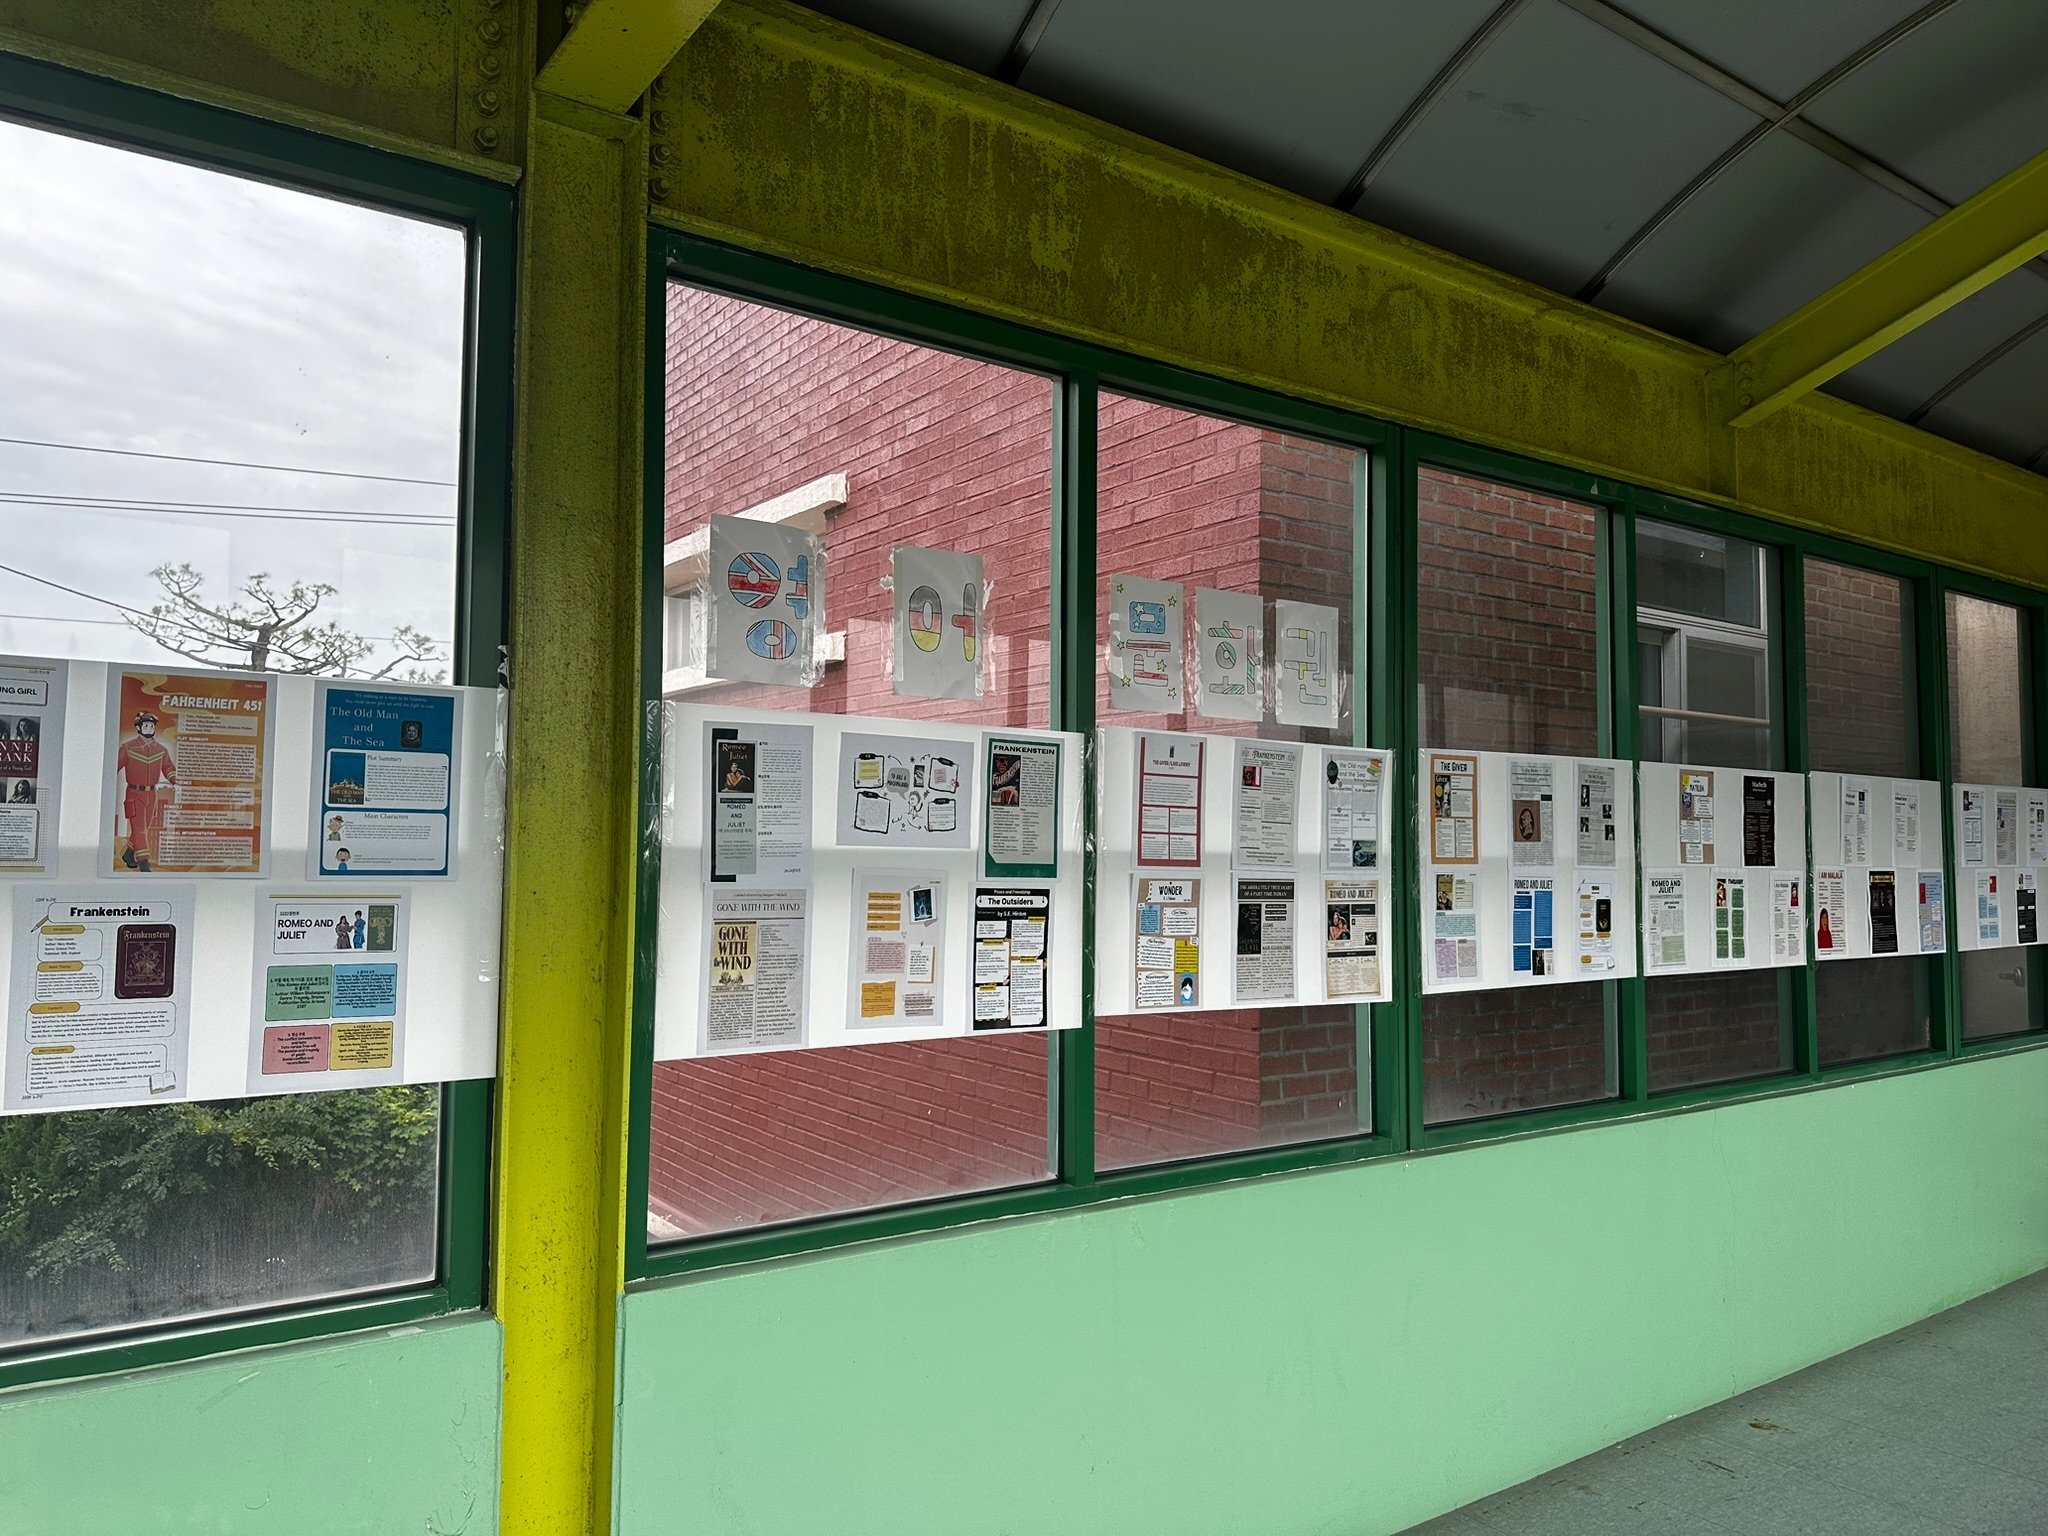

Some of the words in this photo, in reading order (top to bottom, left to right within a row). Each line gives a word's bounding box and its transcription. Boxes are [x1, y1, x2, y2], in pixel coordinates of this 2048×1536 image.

[728, 552, 808, 660] 영
[909, 583, 976, 662] 어
[1126, 601, 1171, 687] 문
[1208, 621, 1260, 694] 화
[1284, 628, 1327, 705] 권
[17, 687, 37, 695] GIRL
[162, 695, 239, 710] FAHRENHEIT
[243, 700, 262, 712] 451
[330, 706, 351, 716] The
[354, 708, 373, 718] Old
[376, 709, 400, 720] Man
[353, 723, 373, 732] and
[341, 735, 363, 746] The
[365, 737, 385, 747] Sea
[722, 743, 747, 752] Romeo
[993, 744, 1055, 755] FRANKENSTEIN
[0, 752, 32, 763] ANK
[378, 755, 402, 763] Summary
[729, 751, 748, 761] Juliet
[1440, 761, 1451, 772] THE
[1452, 761, 1467, 772] GIVER
[1514, 879, 1529, 889] ROMEO
[1530, 879, 1539, 889] AND
[1539, 879, 1553, 890] JULIET
[1658, 886, 1675, 894] JULIET
[1158, 885, 1183, 896] WONDER
[1329, 890, 1346, 899] ROMEO
[1347, 890, 1357, 899] AND
[1357, 890, 1374, 899] JULIET
[987, 897, 1001, 905] The
[1001, 897, 1034, 905] Outsiders
[70, 906, 150, 917] Frankenstein
[716, 903, 739, 912] GONE
[741, 903, 761, 912] WITH
[763, 903, 778, 911] THE
[779, 903, 800, 911] WIND
[277, 919, 313, 928] ROMEO
[314, 919, 334, 928] AND
[123, 930, 170, 941] Frankenstein
[277, 931, 307, 940] JULIET
[719, 926, 749, 941] GONE
[717, 941, 748, 956] WITH
[720, 955, 752, 970] WIND
